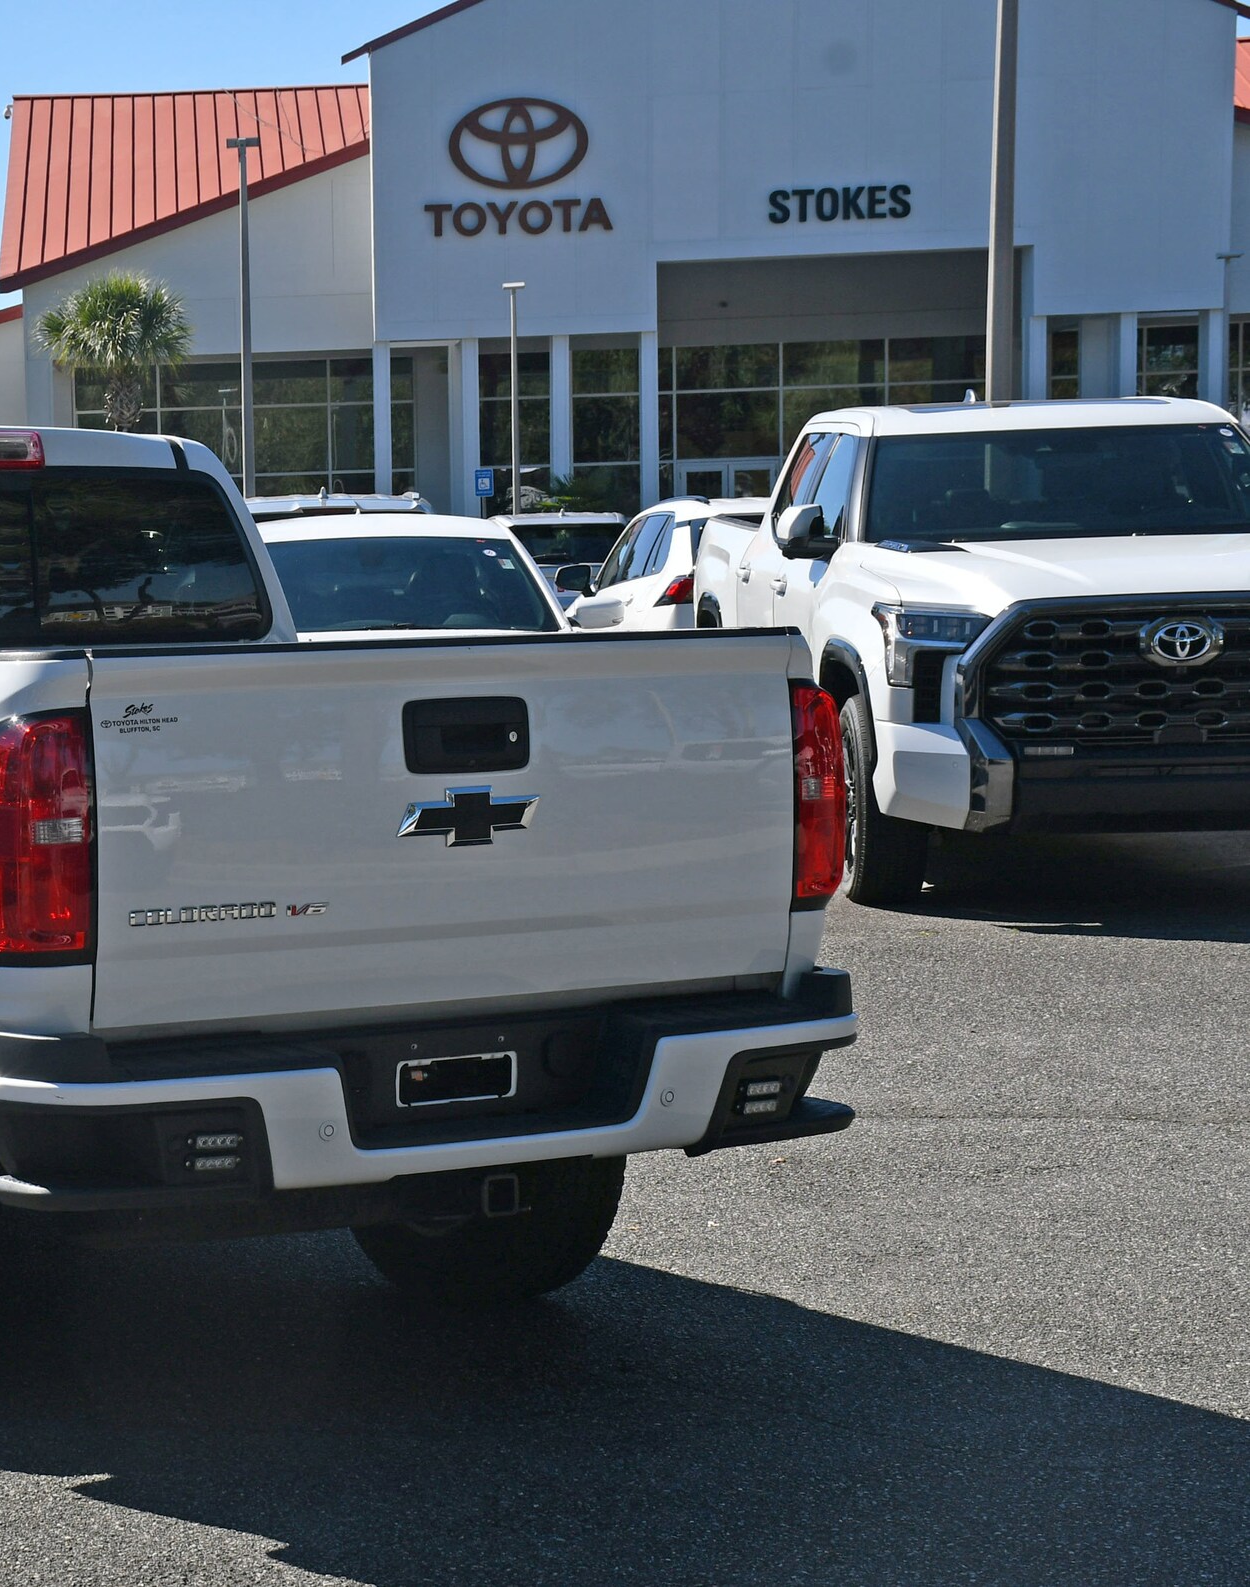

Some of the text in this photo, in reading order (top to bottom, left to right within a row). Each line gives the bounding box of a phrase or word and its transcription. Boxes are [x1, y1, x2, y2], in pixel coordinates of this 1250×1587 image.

[768, 184, 912, 224] STOKES
[425, 198, 613, 237] TOYOTA
[122, 702, 154, 718] Stokes
[112, 719, 139, 727] TOYOTA
[129, 901, 330, 926] COLORADO V6
